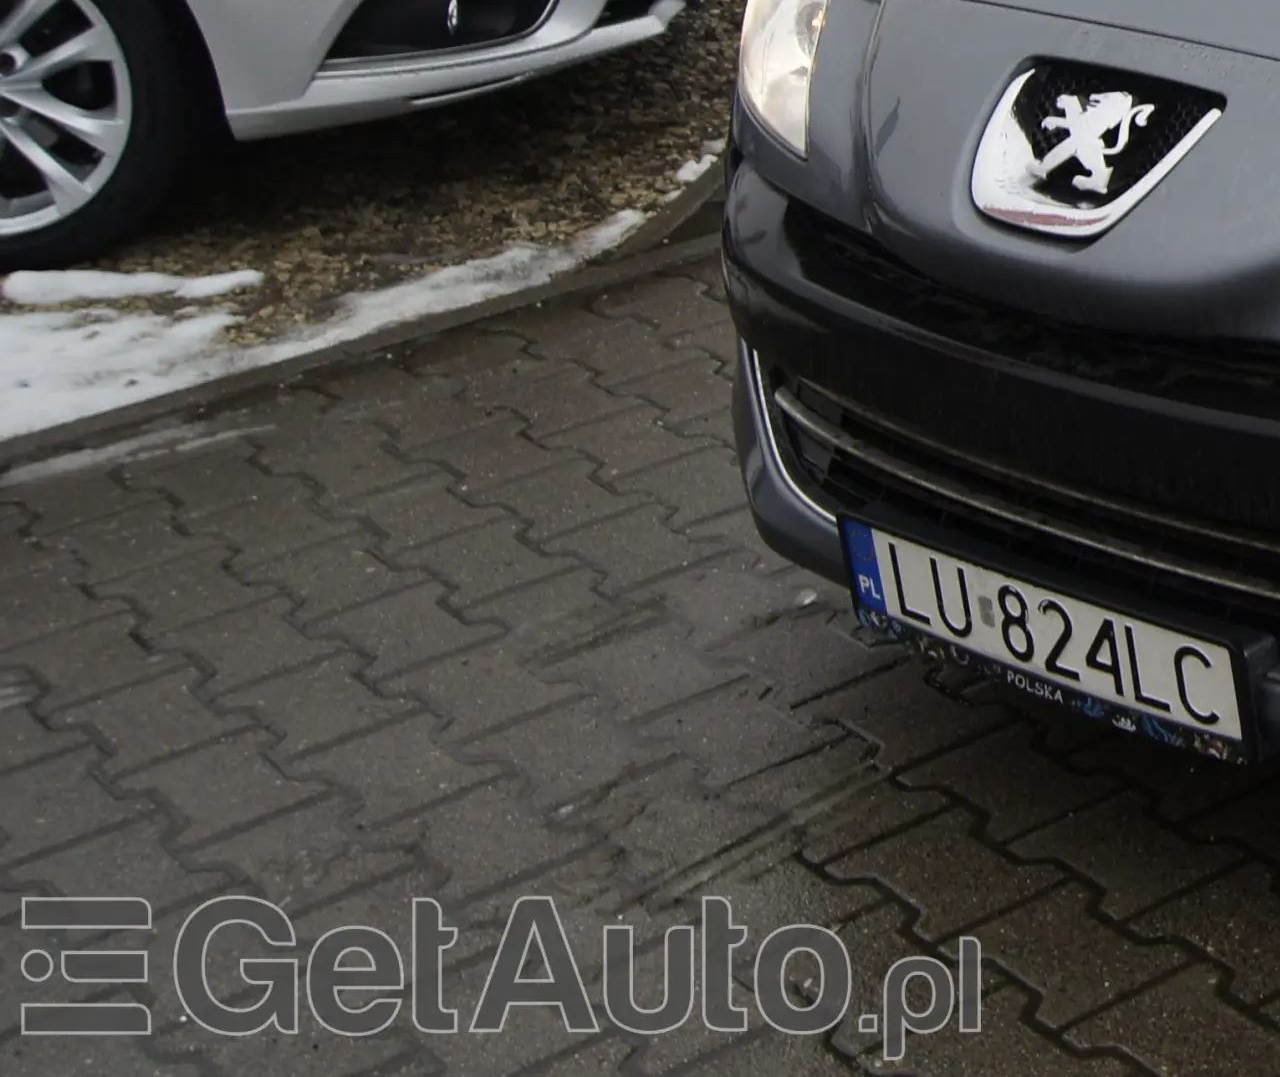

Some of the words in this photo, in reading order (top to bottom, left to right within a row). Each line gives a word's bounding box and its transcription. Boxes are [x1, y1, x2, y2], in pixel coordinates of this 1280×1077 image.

[859, 574, 881, 600] PL
[888, 541, 973, 639] LU
[997, 583, 1221, 726] 824LC
[1007, 669, 1063, 704] POLSKA
